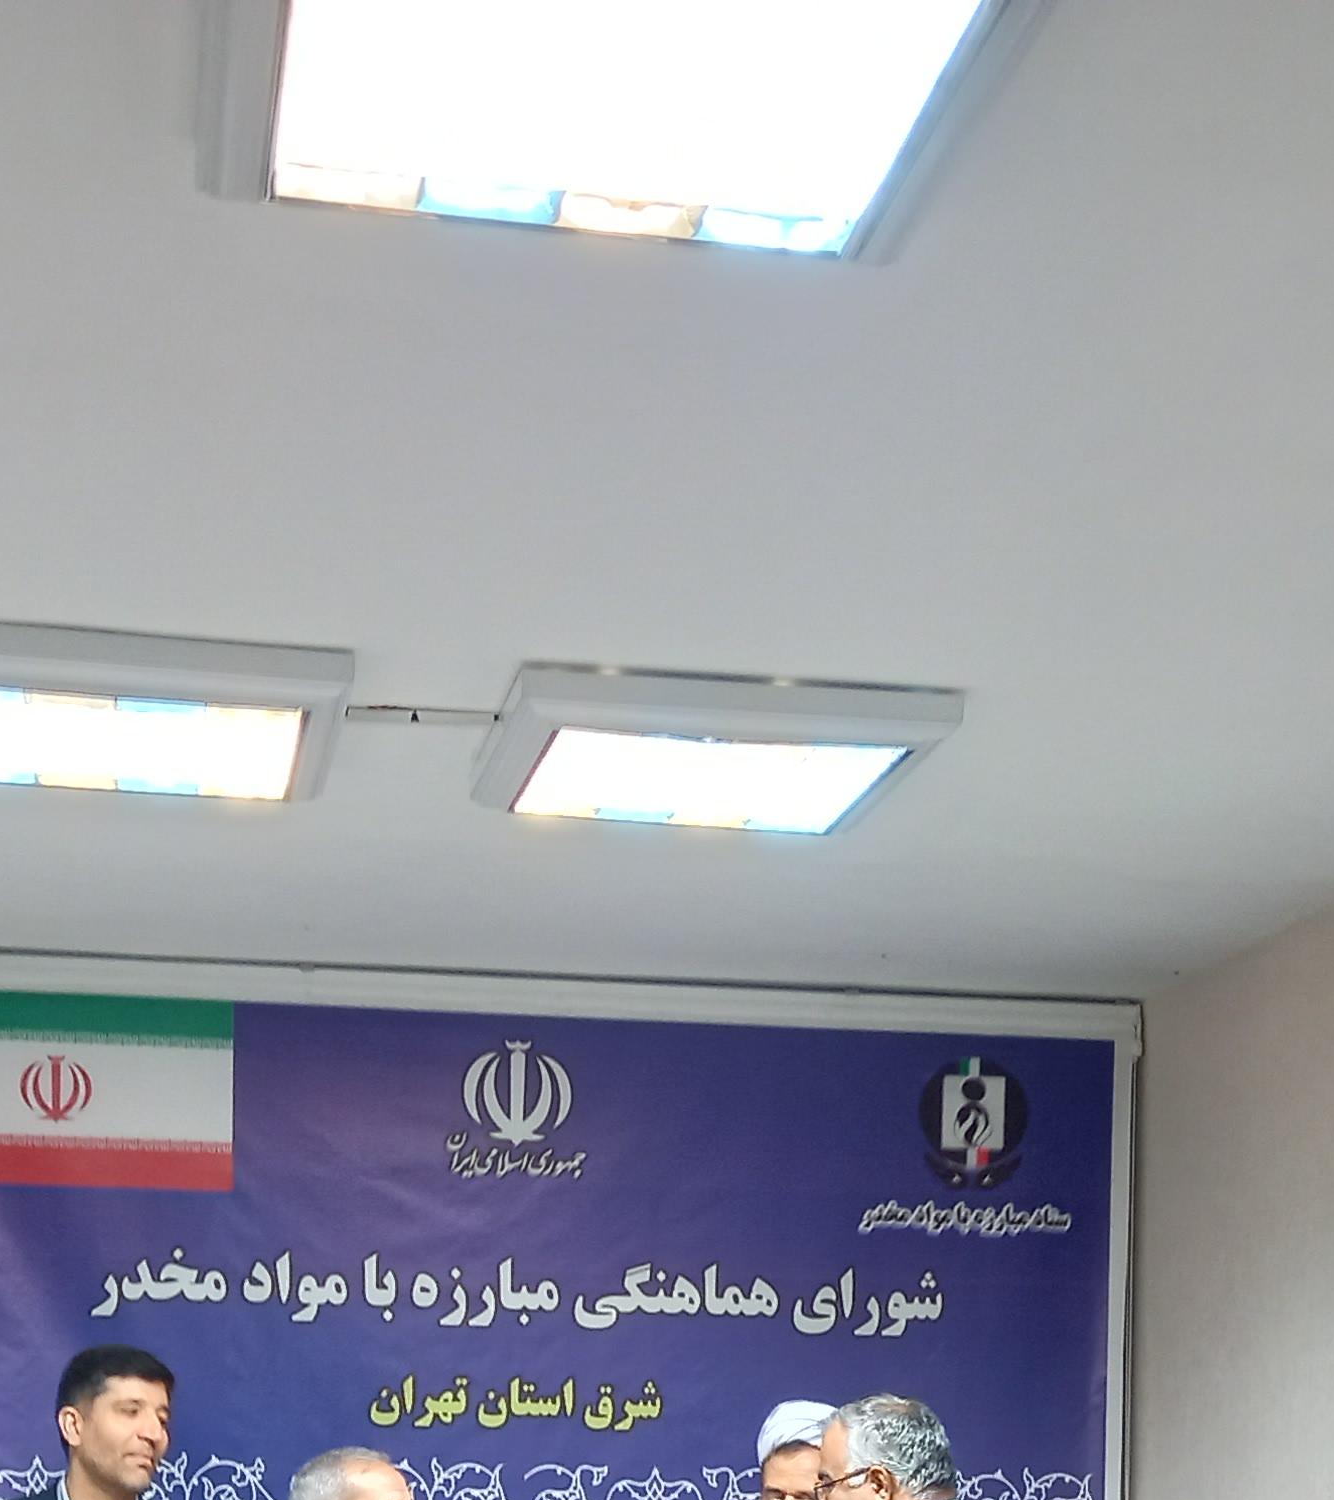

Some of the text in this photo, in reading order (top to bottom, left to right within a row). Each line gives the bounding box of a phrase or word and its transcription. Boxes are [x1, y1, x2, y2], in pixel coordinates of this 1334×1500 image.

[446, 1132, 586, 1179] جمهوری اسلامی ایران
[90, 1247, 944, 1337] شورای هماهنگی مبارزه با مواد مخدر
[369, 1374, 662, 1432] شرق استان تهران
